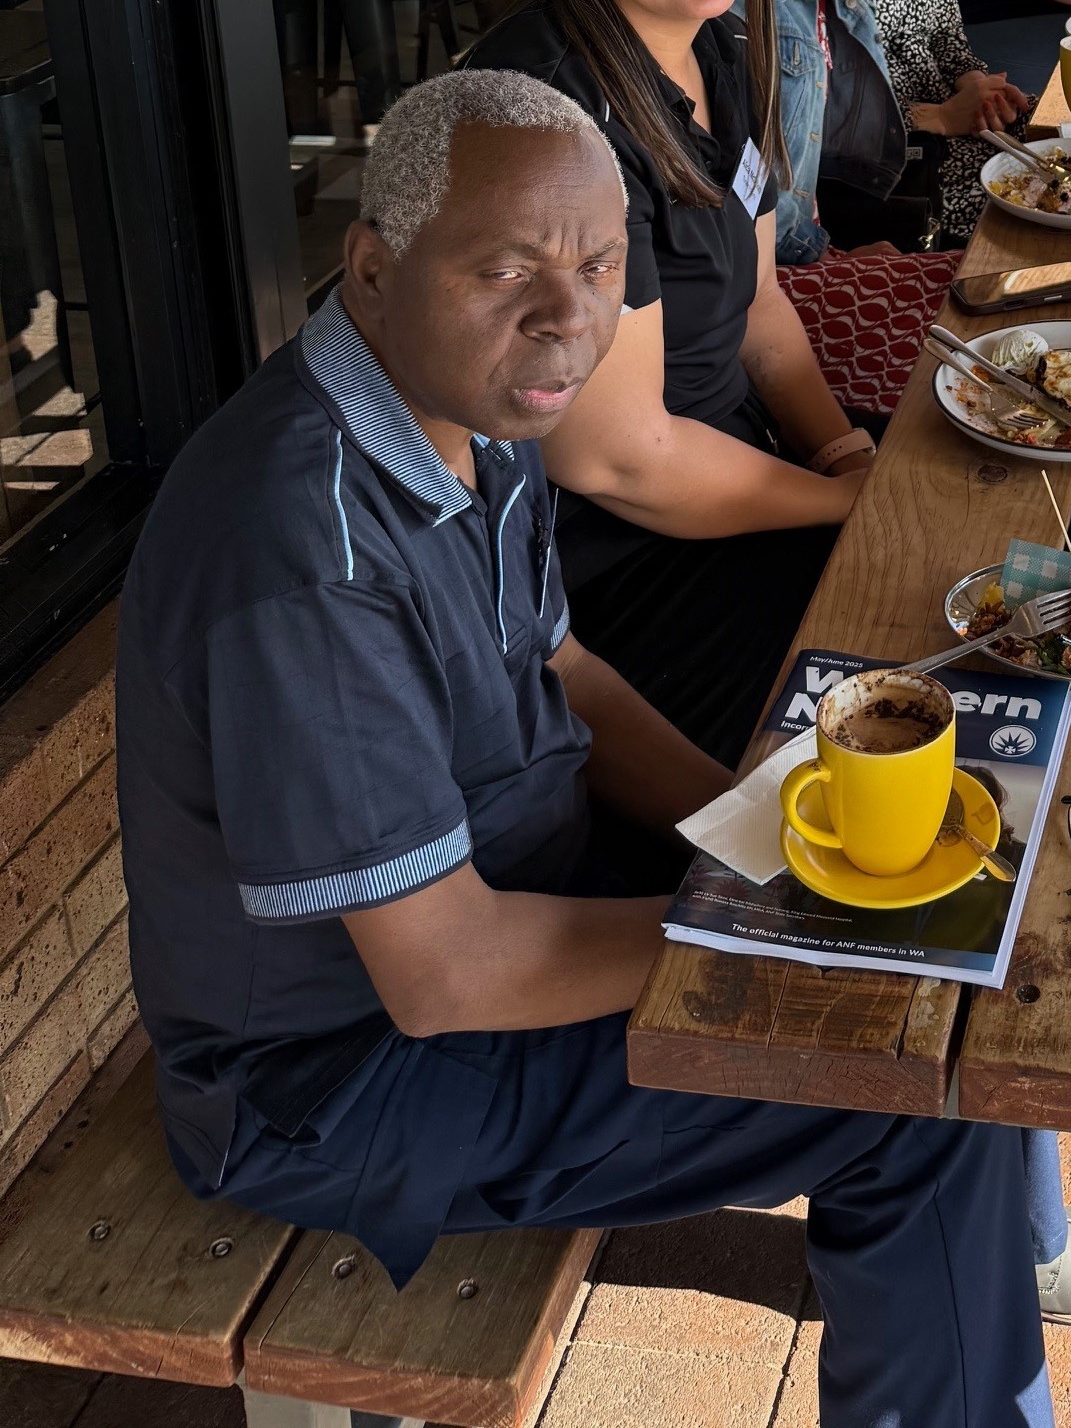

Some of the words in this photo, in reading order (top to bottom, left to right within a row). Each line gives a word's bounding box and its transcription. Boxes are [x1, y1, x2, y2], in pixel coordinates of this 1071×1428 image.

[810, 656, 843, 666] May/June
[805, 666, 1042, 720] Wern
[732, 923, 748, 933] The
[749, 927, 779, 939] official
[780, 933, 821, 946] magazine
[822, 938, 835, 947] for
[857, 944, 896, 954] members
[909, 949, 925, 957] WA
